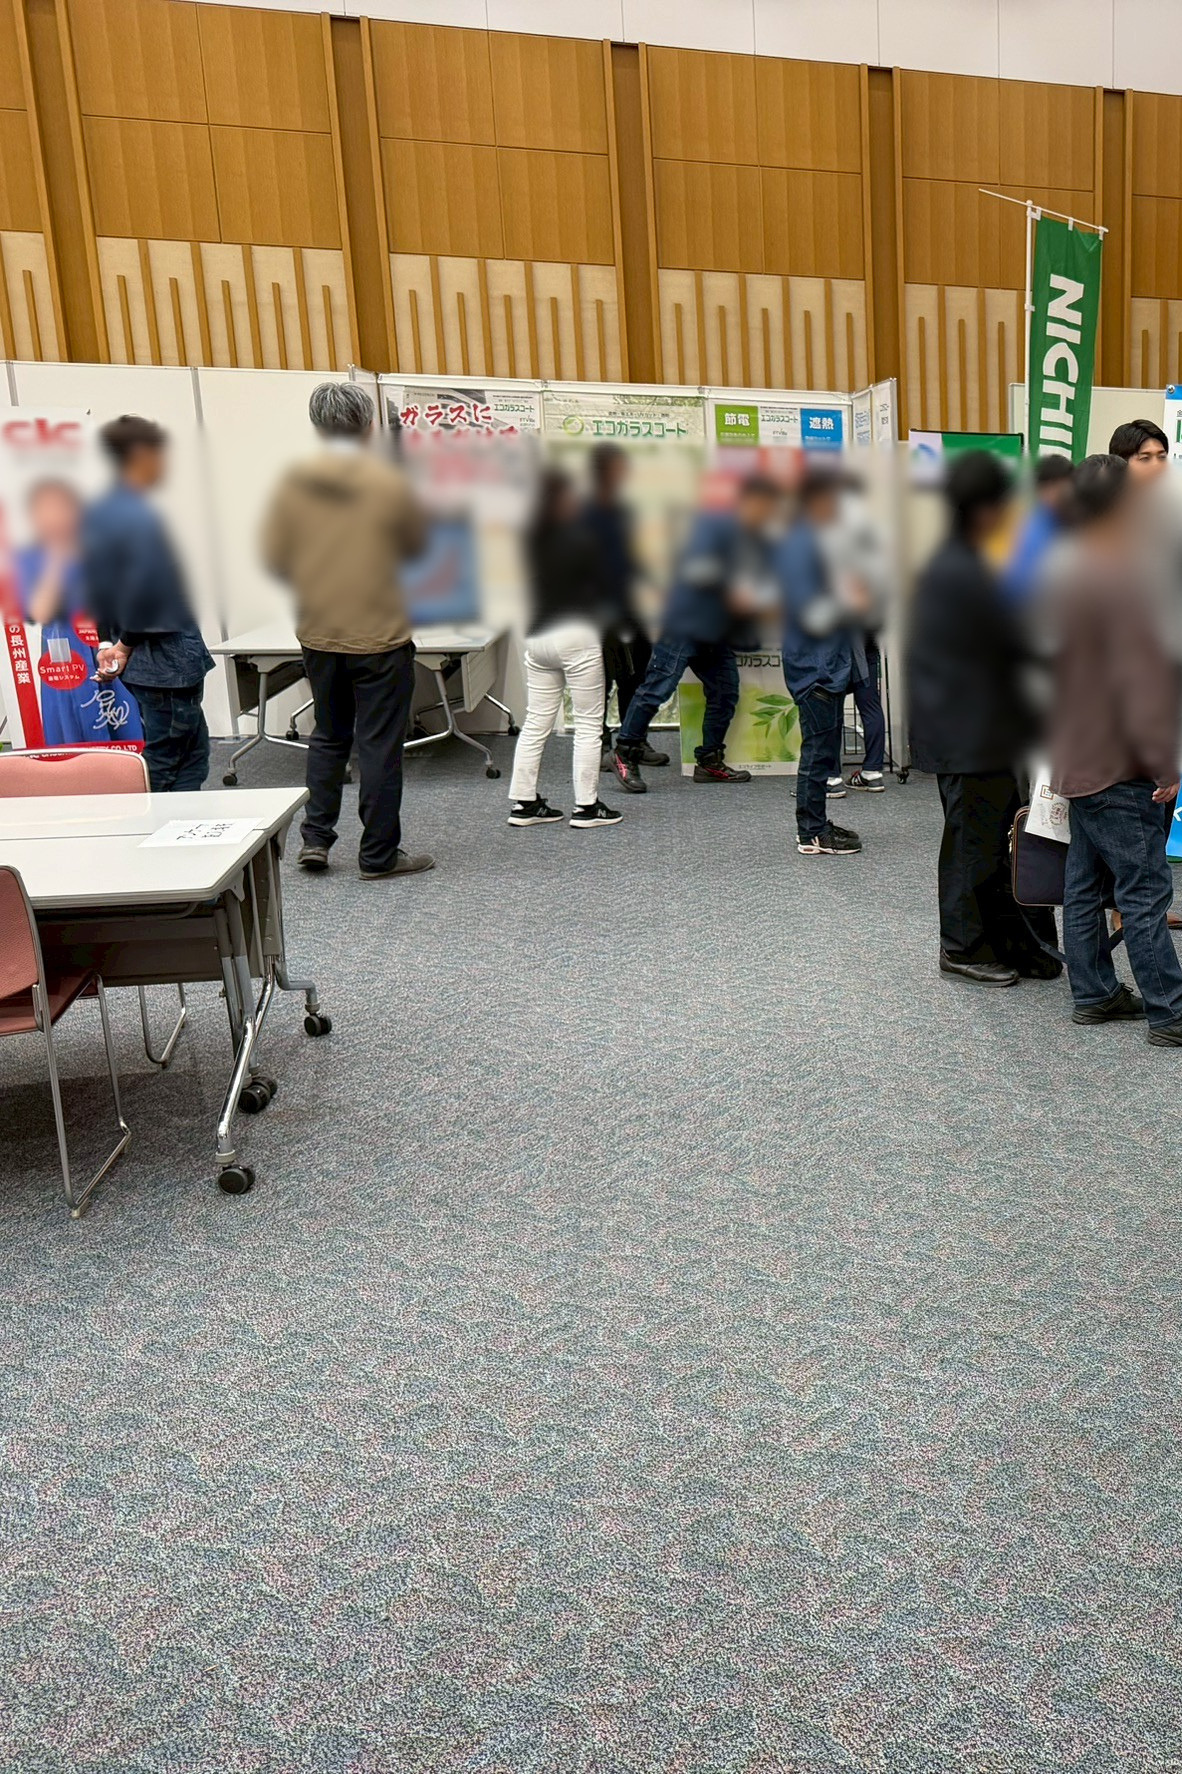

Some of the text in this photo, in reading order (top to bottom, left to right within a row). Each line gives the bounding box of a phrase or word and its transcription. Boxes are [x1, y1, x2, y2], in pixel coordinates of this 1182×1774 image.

[400, 403, 492, 425] ガラスに
[494, 403, 535, 413] エコガラスコート
[725, 413, 750, 427] 節電
[761, 414, 798, 424] エコガラスコート
[809, 417, 835, 430] 遮熱
[592, 420, 687, 438] エコガラスコート
[8, 624, 31, 684] の長州産業
[72, 664, 85, 672] PV
